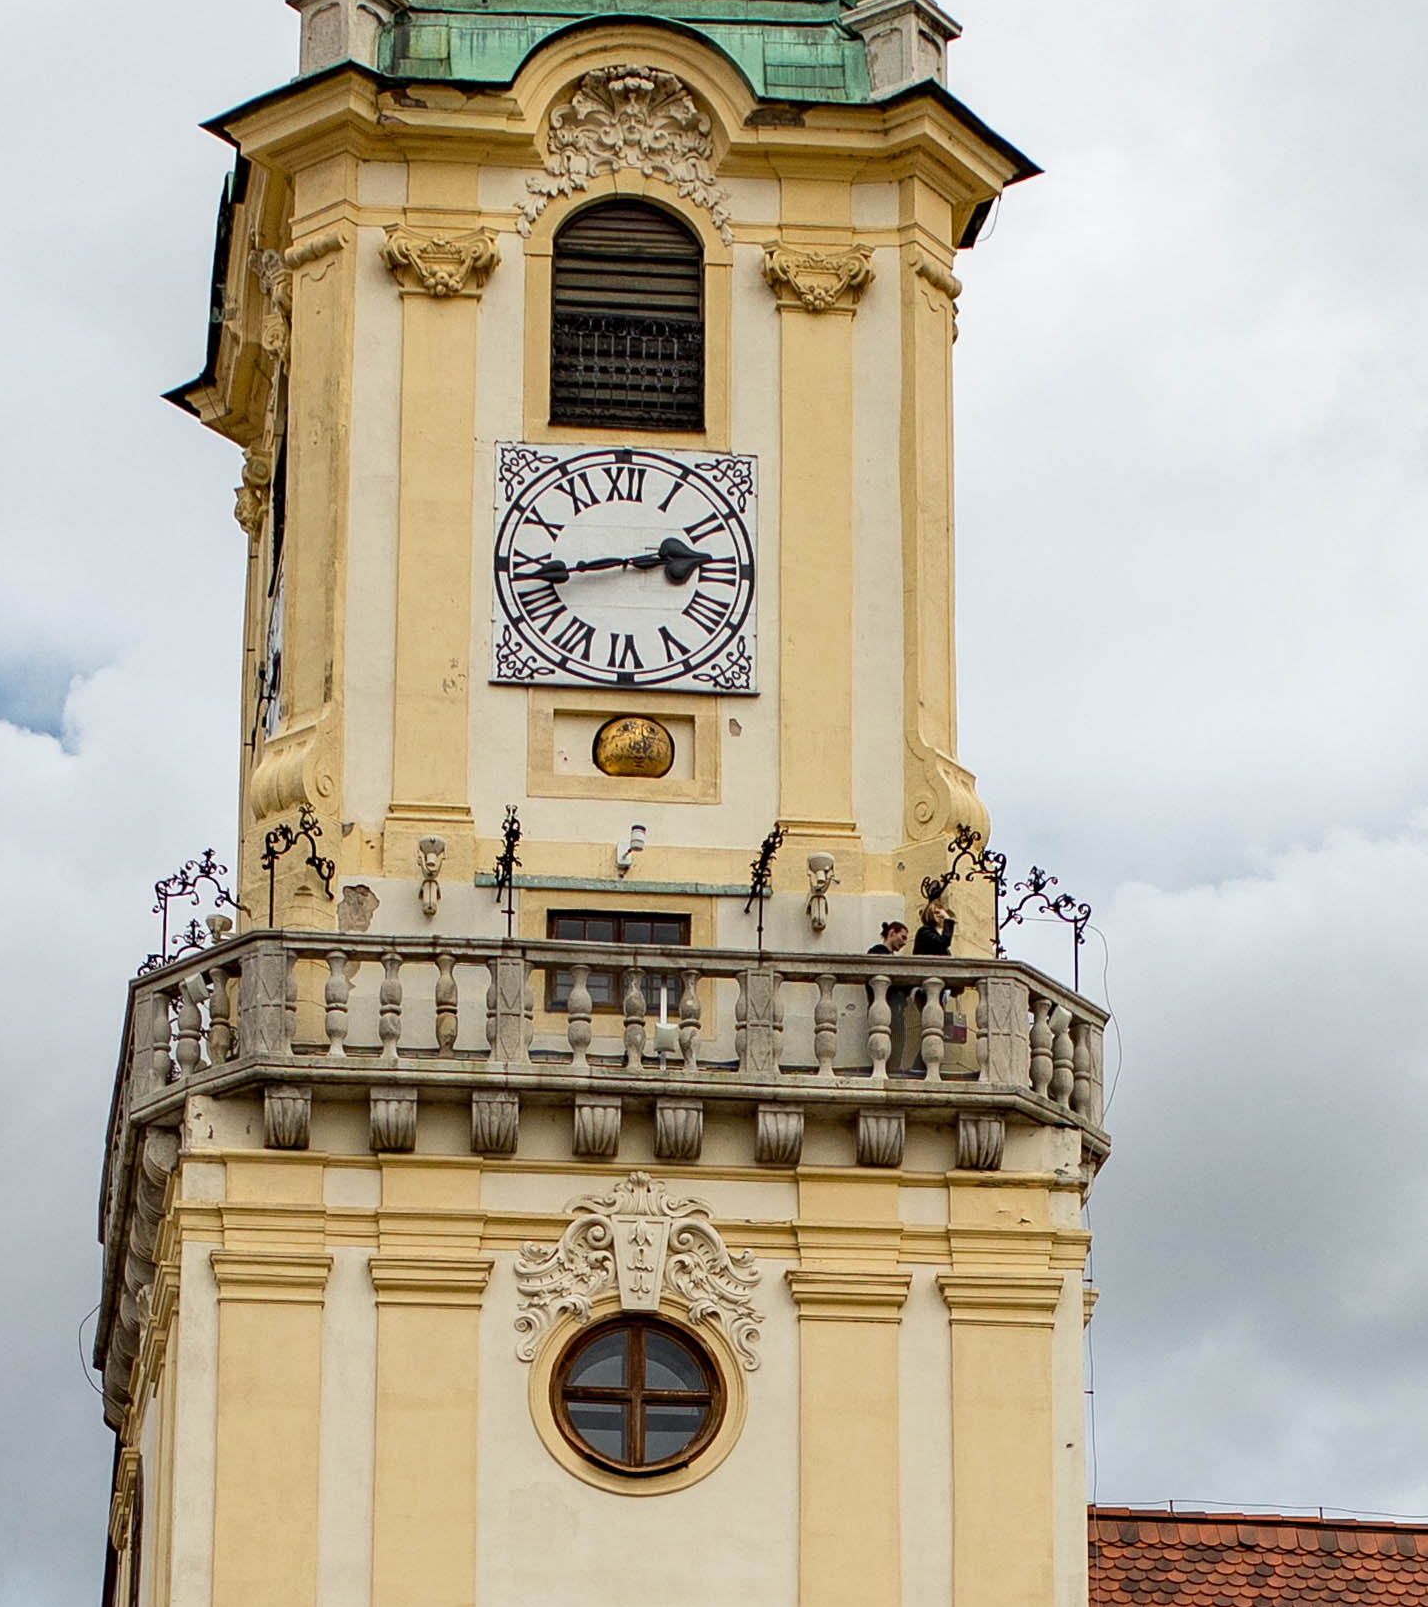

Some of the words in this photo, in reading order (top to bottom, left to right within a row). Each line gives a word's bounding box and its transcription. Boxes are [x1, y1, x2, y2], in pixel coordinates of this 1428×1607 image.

[553, 471, 601, 516] XI
[601, 466, 647, 503] XII
[657, 480, 684, 513] I
[523, 505, 564, 542] X
[682, 512, 726, 544] II
[698, 555, 736, 587] III
[516, 583, 568, 635] VIII
[551, 615, 596, 662] VII
[607, 632, 644, 669] VI
[657, 626, 691, 663] V
